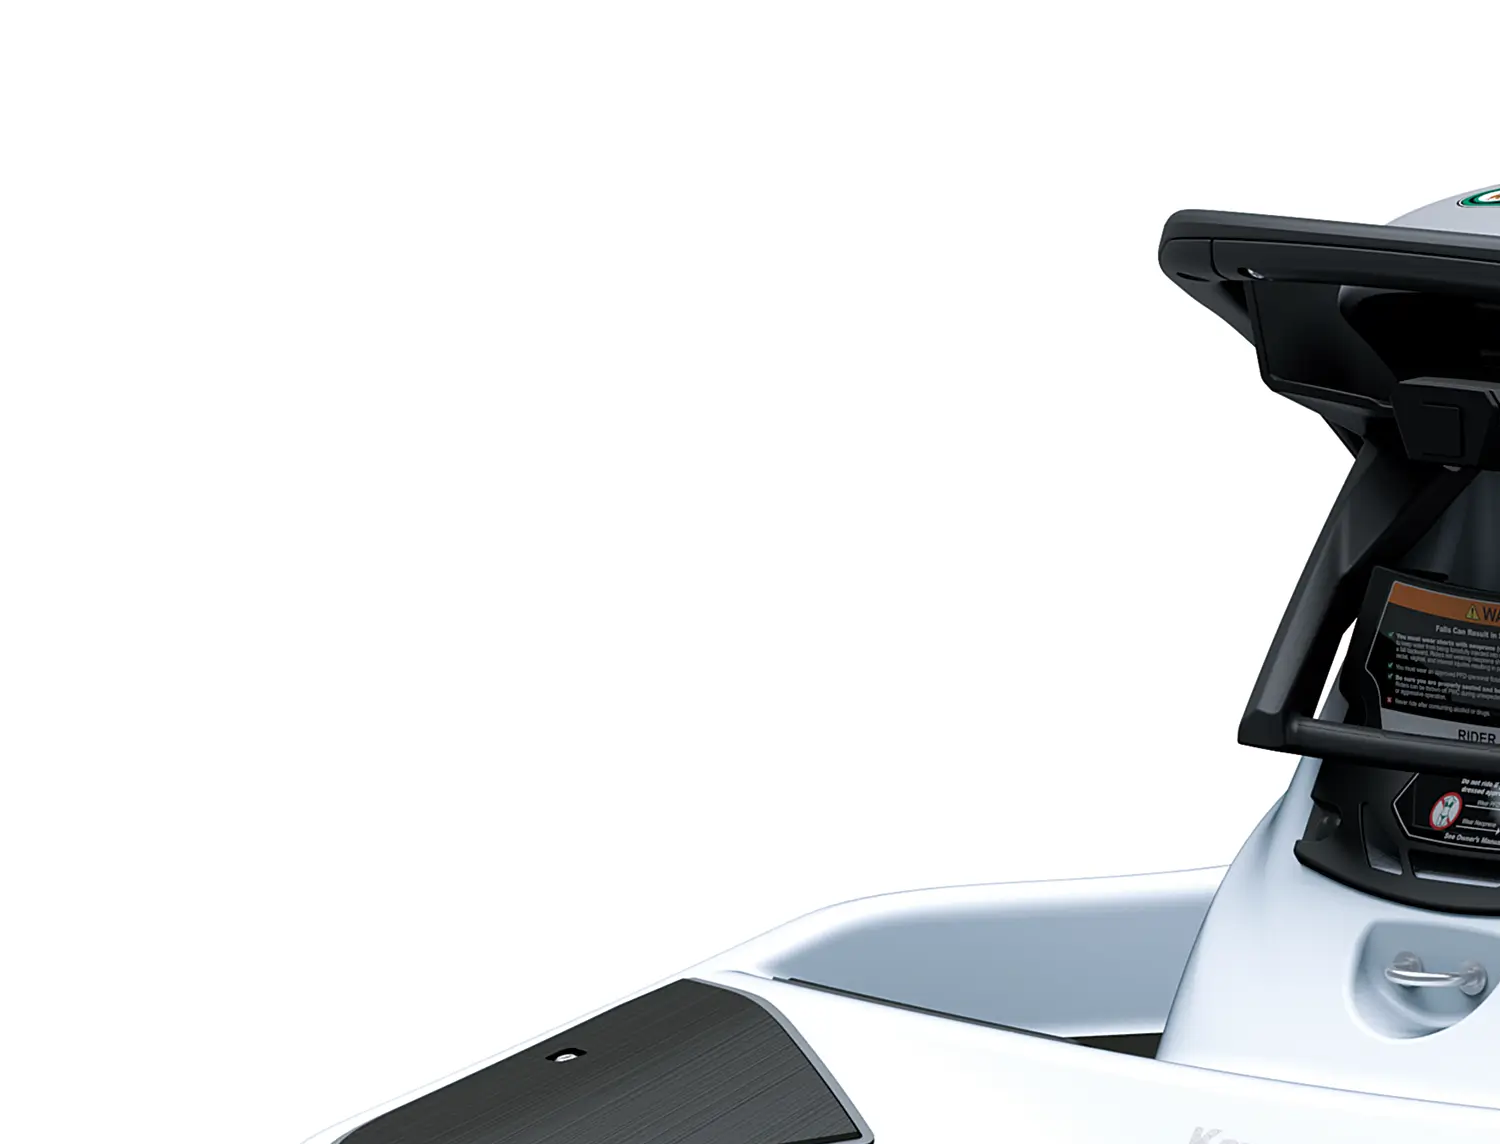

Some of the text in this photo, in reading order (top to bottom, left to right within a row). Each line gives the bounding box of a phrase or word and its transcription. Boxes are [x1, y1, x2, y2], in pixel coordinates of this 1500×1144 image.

[1435, 624, 1452, 634] Falls
[1452, 626, 1467, 636] Can
[1467, 628, 1489, 639] Result
[1458, 729, 1496, 745] RIDER
[1461, 786, 1485, 795] dressed
[1481, 780, 1493, 788] ride
[1443, 831, 1456, 840] See
[1456, 834, 1480, 844] Owner's
